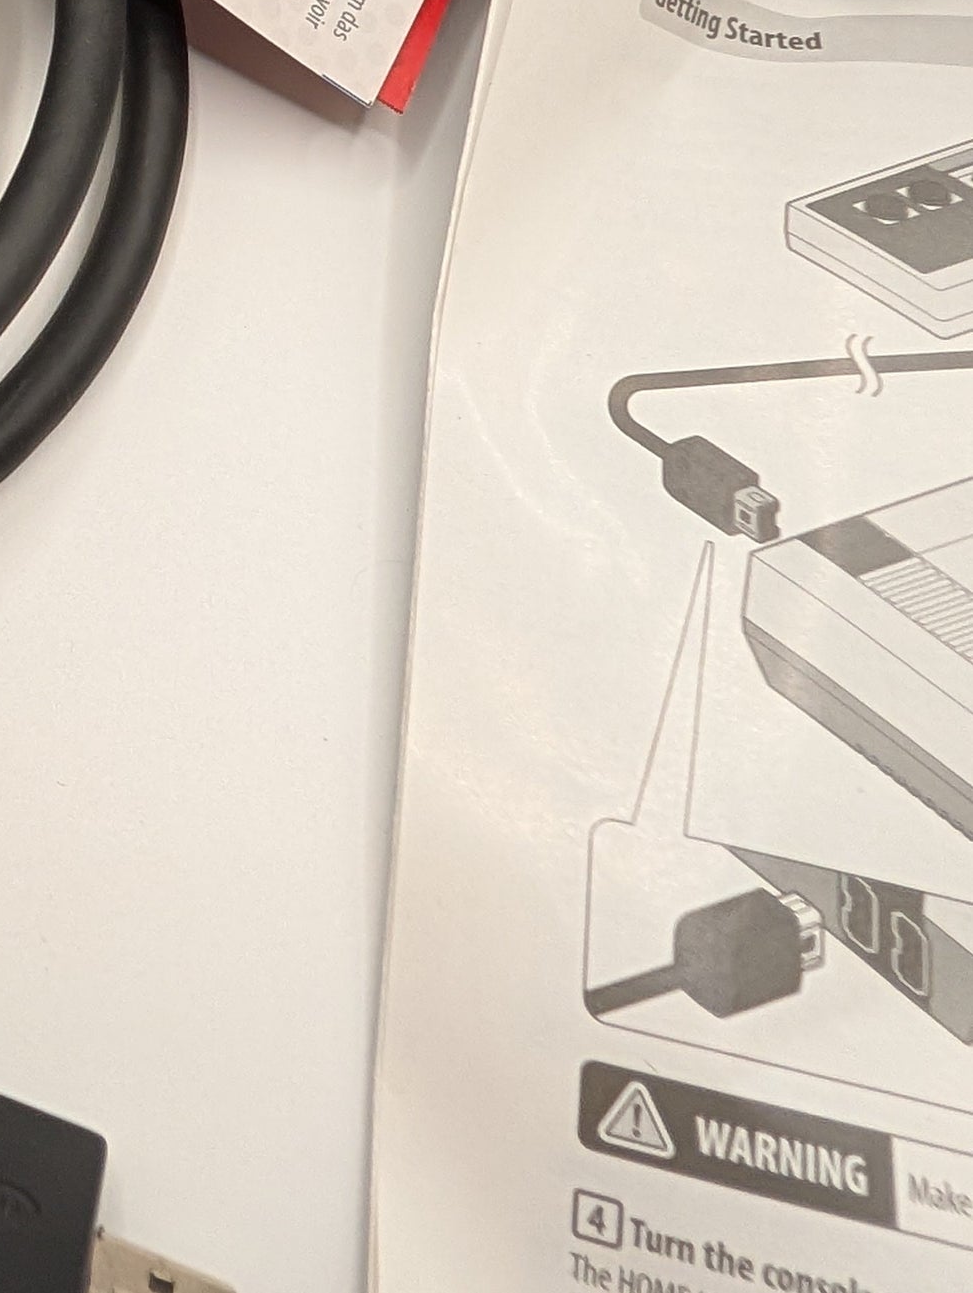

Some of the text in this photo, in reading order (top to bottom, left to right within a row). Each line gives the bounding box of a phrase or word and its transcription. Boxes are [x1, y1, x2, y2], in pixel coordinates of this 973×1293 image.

[333, 12, 359, 41] das
[724, 17, 823, 50] Started
[695, 1115, 972, 1217] WARNING Make
[587, 1204, 873, 1293] 4 Turn the consl
[569, 1252, 613, 1291] The
